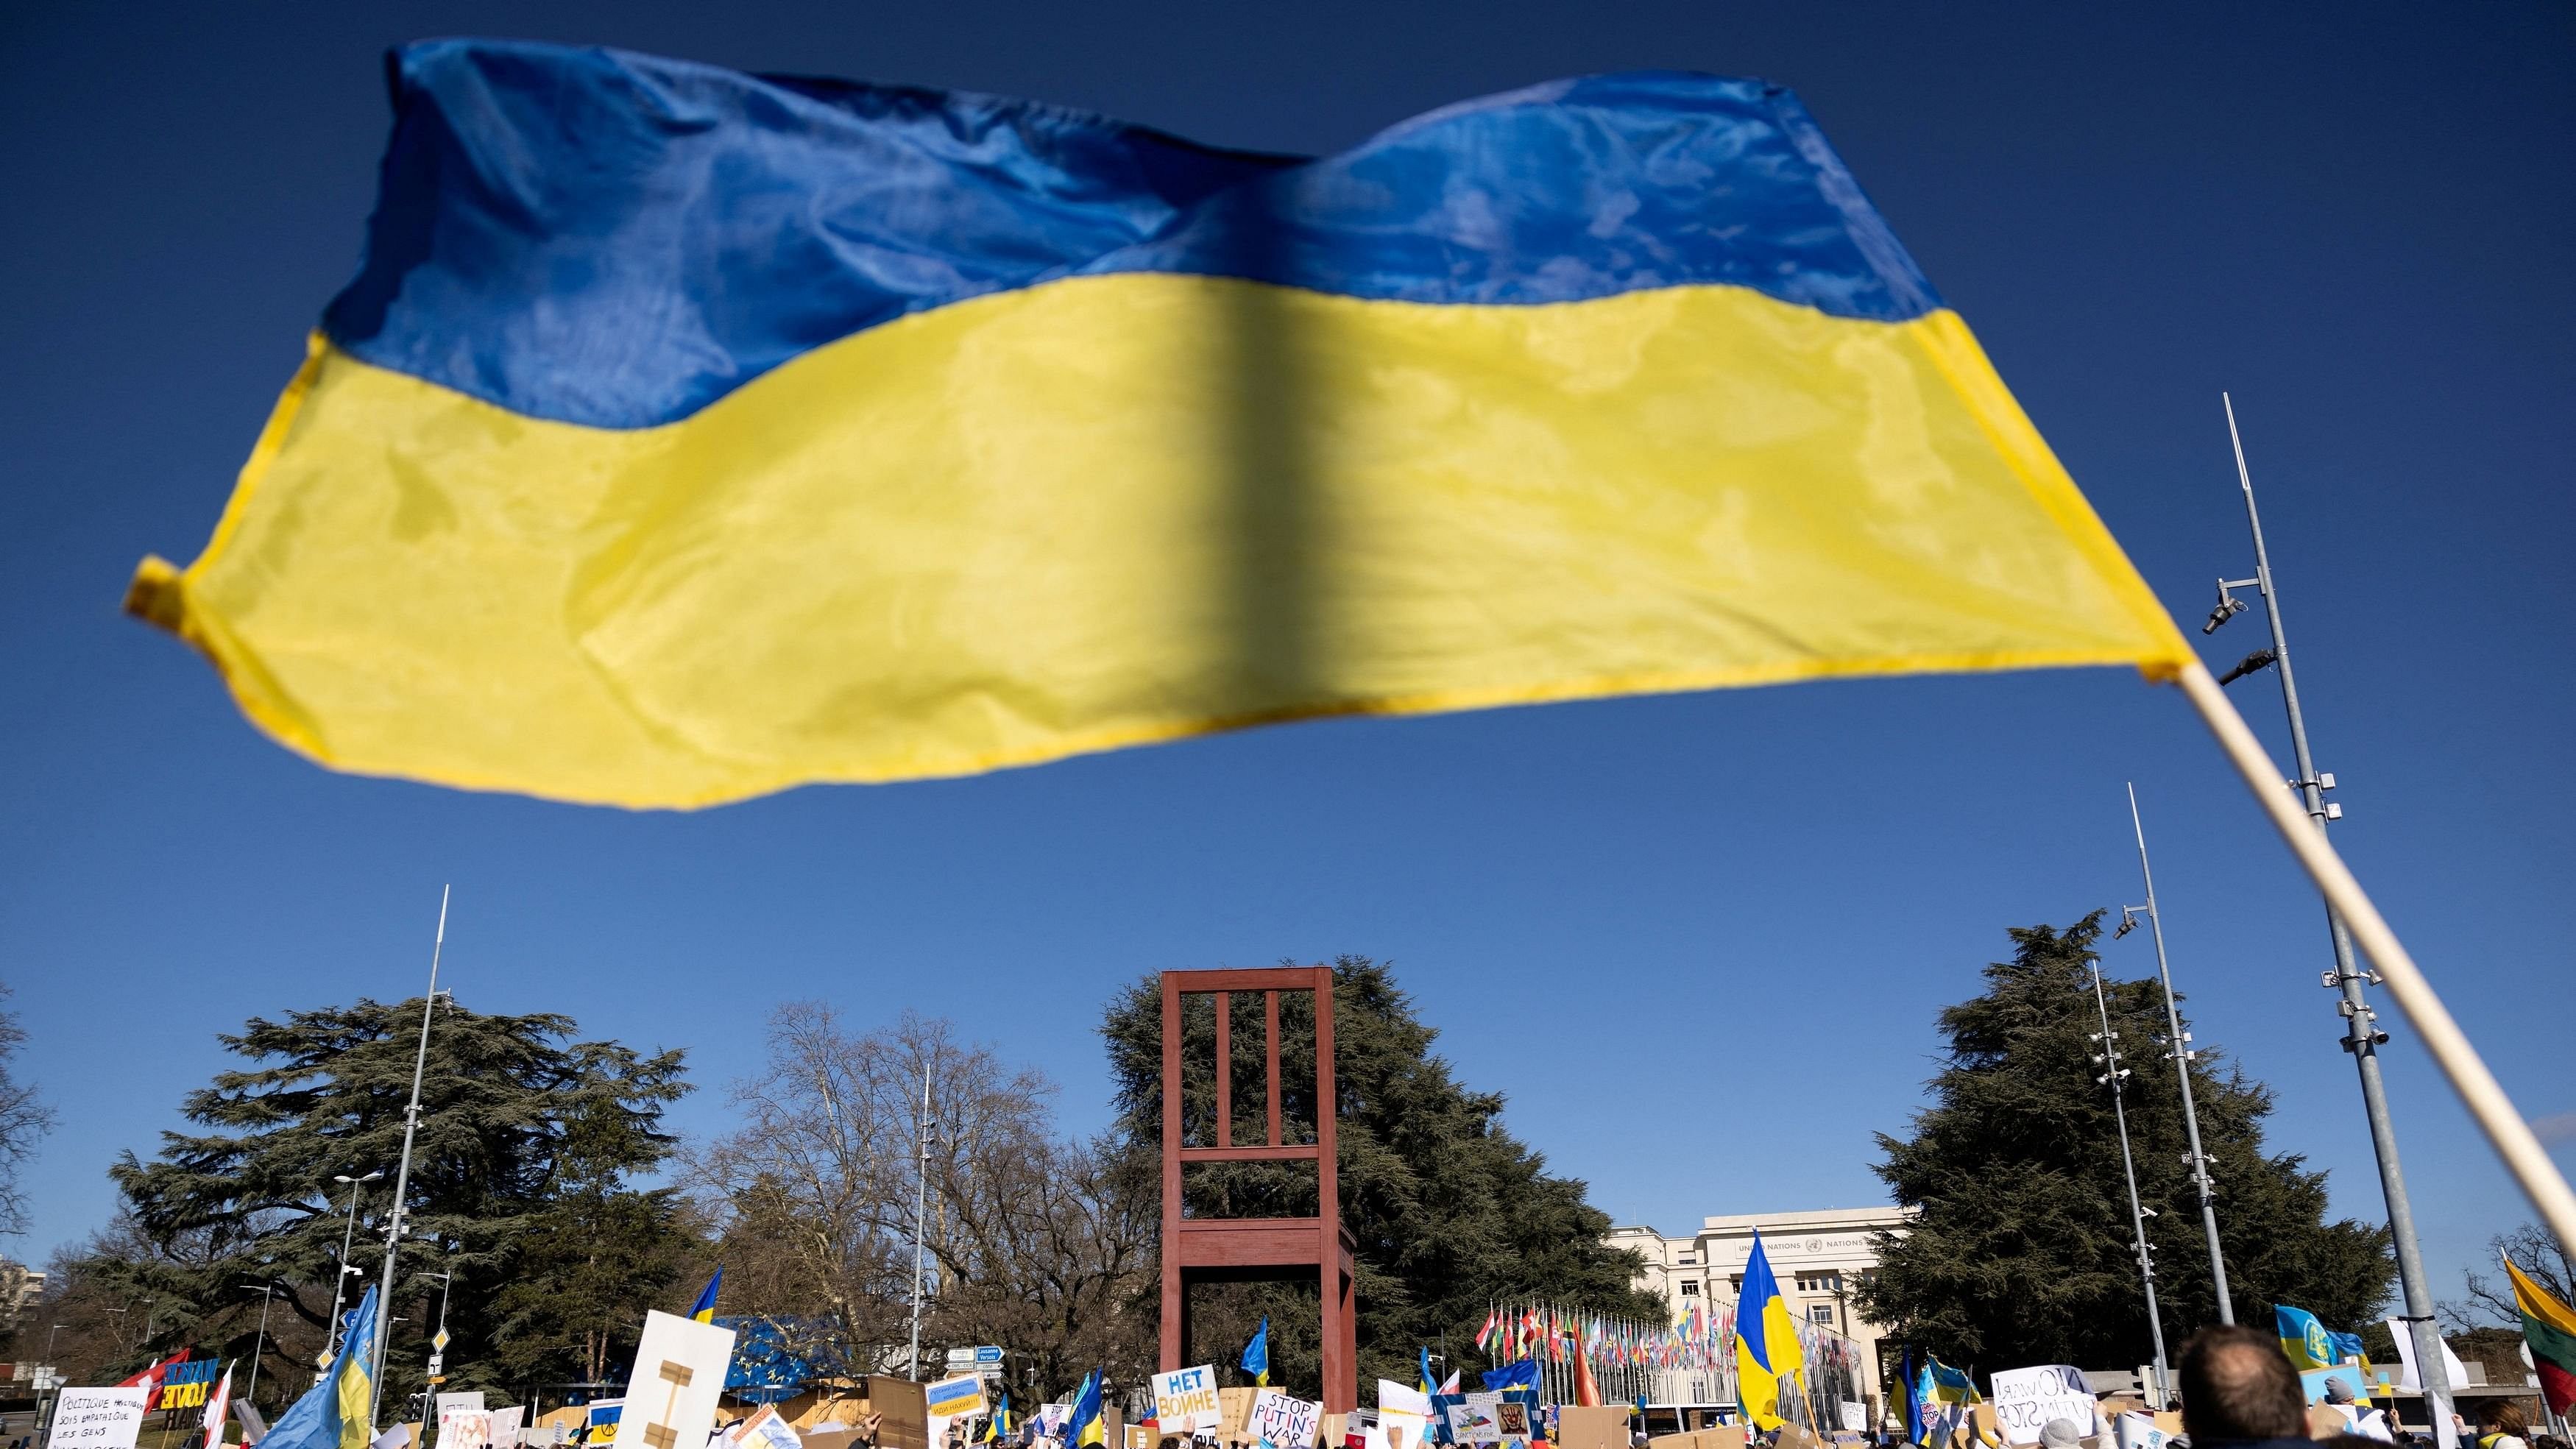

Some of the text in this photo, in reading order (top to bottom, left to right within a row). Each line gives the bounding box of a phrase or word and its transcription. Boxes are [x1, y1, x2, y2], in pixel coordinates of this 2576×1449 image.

[1767, 1242, 1801, 1250] NATIONS
[1168, 1370, 1202, 1395] НЕТ
[930, 1386, 951, 1395] Русский
[943, 1391, 965, 1400] корабль
[61, 1396, 110, 1413] POLITIQUE
[1158, 1389, 1216, 1418] ВОЙНЕ
[1269, 1395, 1311, 1416] STOP
[933, 1406, 949, 1414] ИДИ
[1051, 1405, 1063, 1414] STOP
[58, 1415, 77, 1425] SOIS
[1255, 1404, 1317, 1434] PUTIN'S
[1922, 1411, 1939, 1420] STOP
[57, 1428, 106, 1439] LES GENS
[1264, 1422, 1301, 1446] WAR
